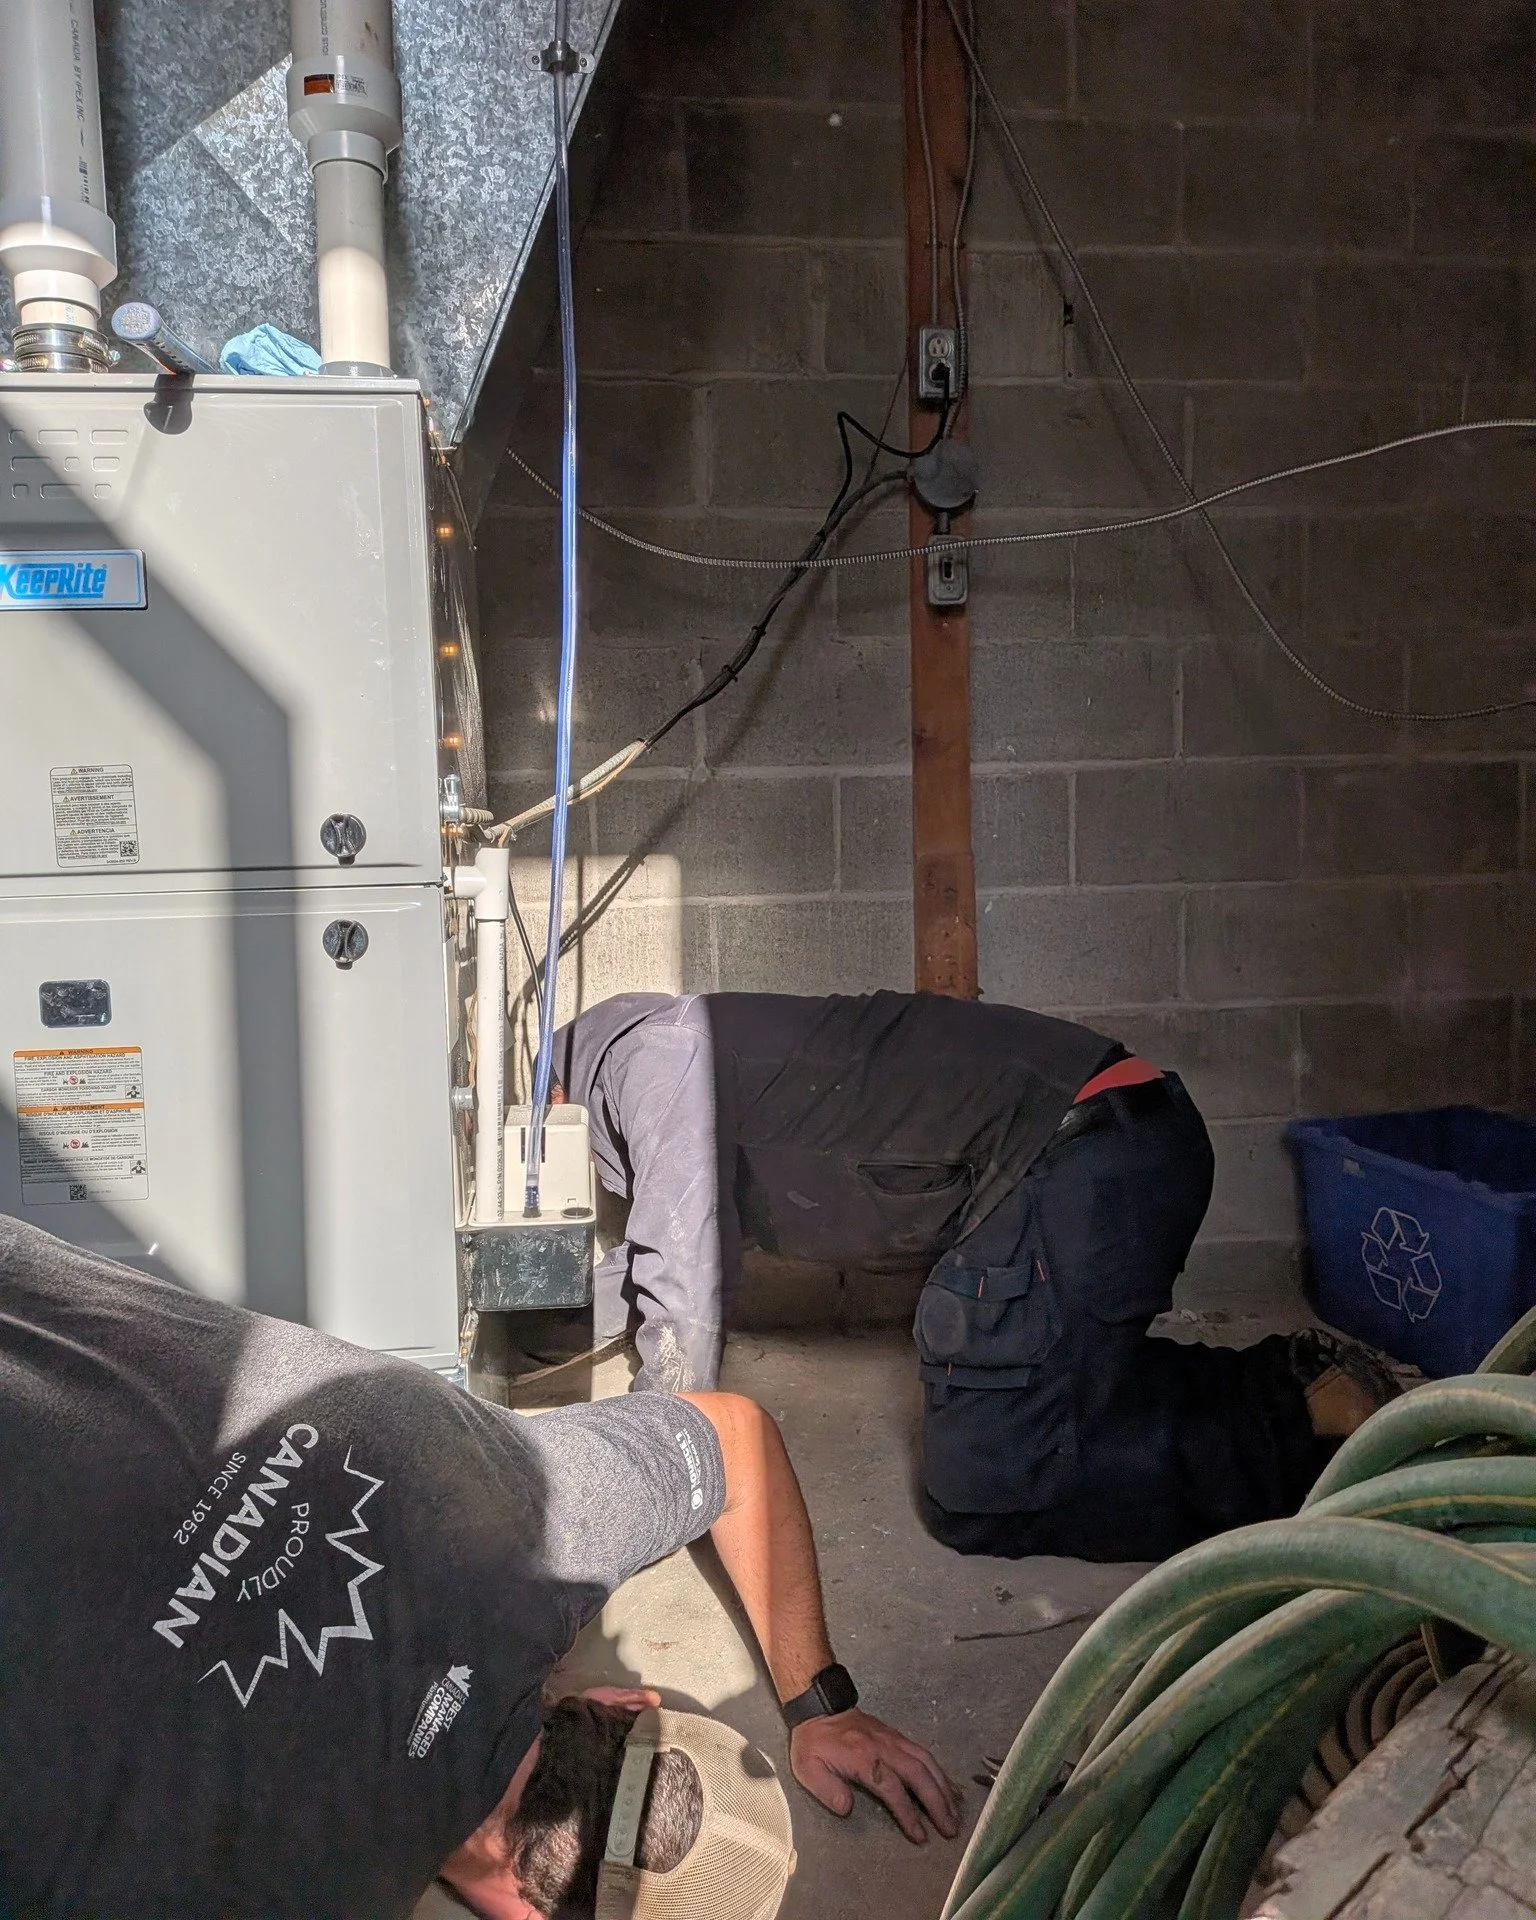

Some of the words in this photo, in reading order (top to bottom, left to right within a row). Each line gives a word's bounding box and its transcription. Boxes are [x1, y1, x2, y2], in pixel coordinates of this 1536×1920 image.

[208, 1452, 246, 1499] SINCE
[152, 1423, 319, 1649] CANADIAN
[173, 1499, 212, 1545] 1952
[236, 1502, 310, 1602] PROUDLY
[441, 1678, 467, 1705] CANADA'S
[443, 1700, 462, 1732] BEST
[408, 1686, 445, 1759] COMPANIES
[416, 1692, 454, 1759] MANAGED
